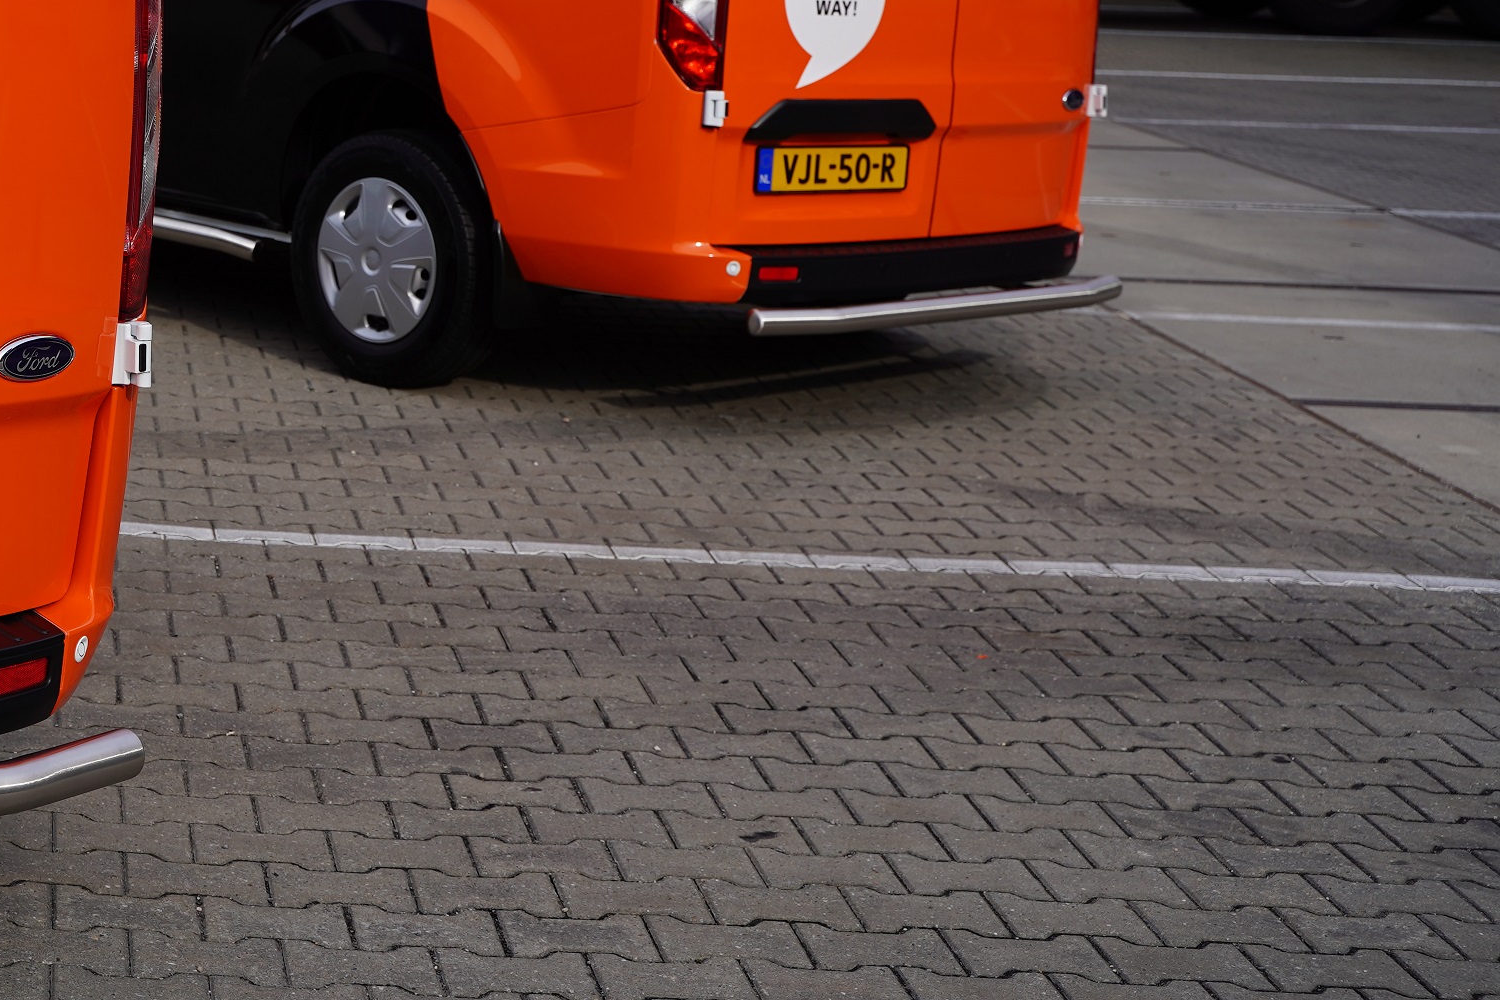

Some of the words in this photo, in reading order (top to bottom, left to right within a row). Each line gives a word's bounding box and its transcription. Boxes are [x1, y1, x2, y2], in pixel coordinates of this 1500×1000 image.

[816, 0, 857, 16] WAY!
[759, 174, 771, 184] NL
[783, 153, 895, 184] VJL-50-R
[16, 346, 60, 373] Ford
